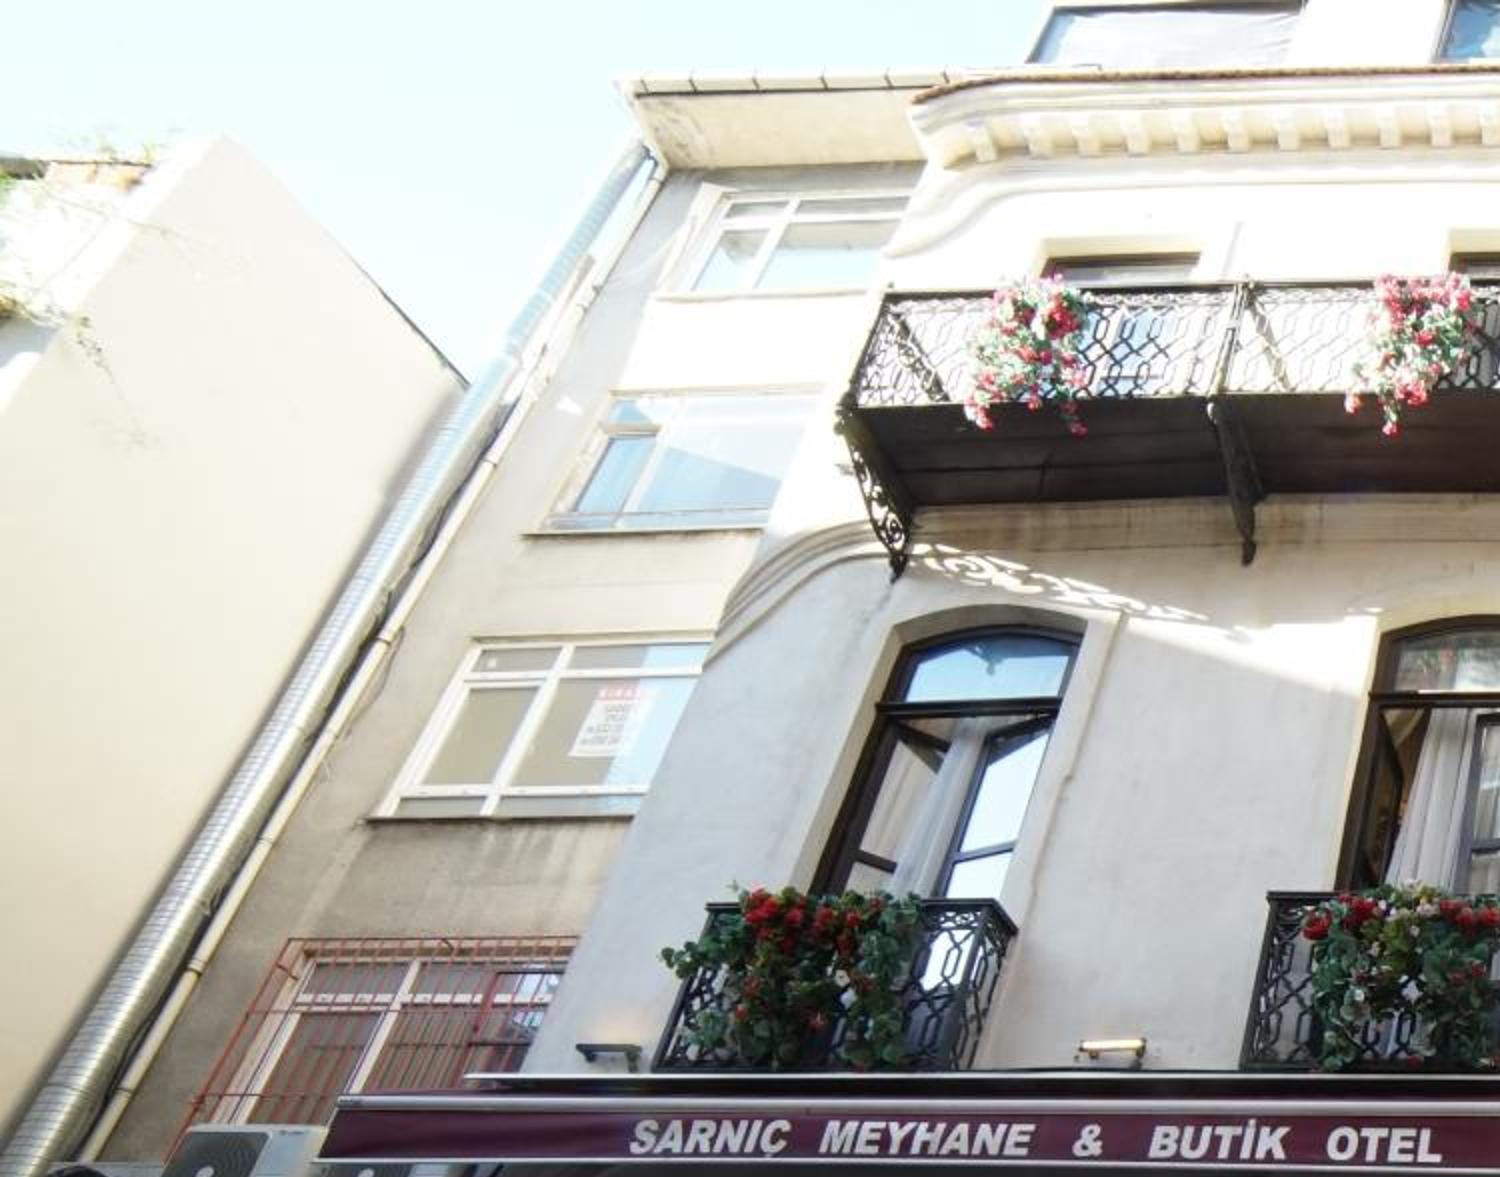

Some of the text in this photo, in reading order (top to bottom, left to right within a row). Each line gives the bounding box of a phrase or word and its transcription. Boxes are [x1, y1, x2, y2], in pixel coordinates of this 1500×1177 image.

[629, 1119, 1442, 1163] SARNIÇ MEYHANE & BUTİK OTEL
